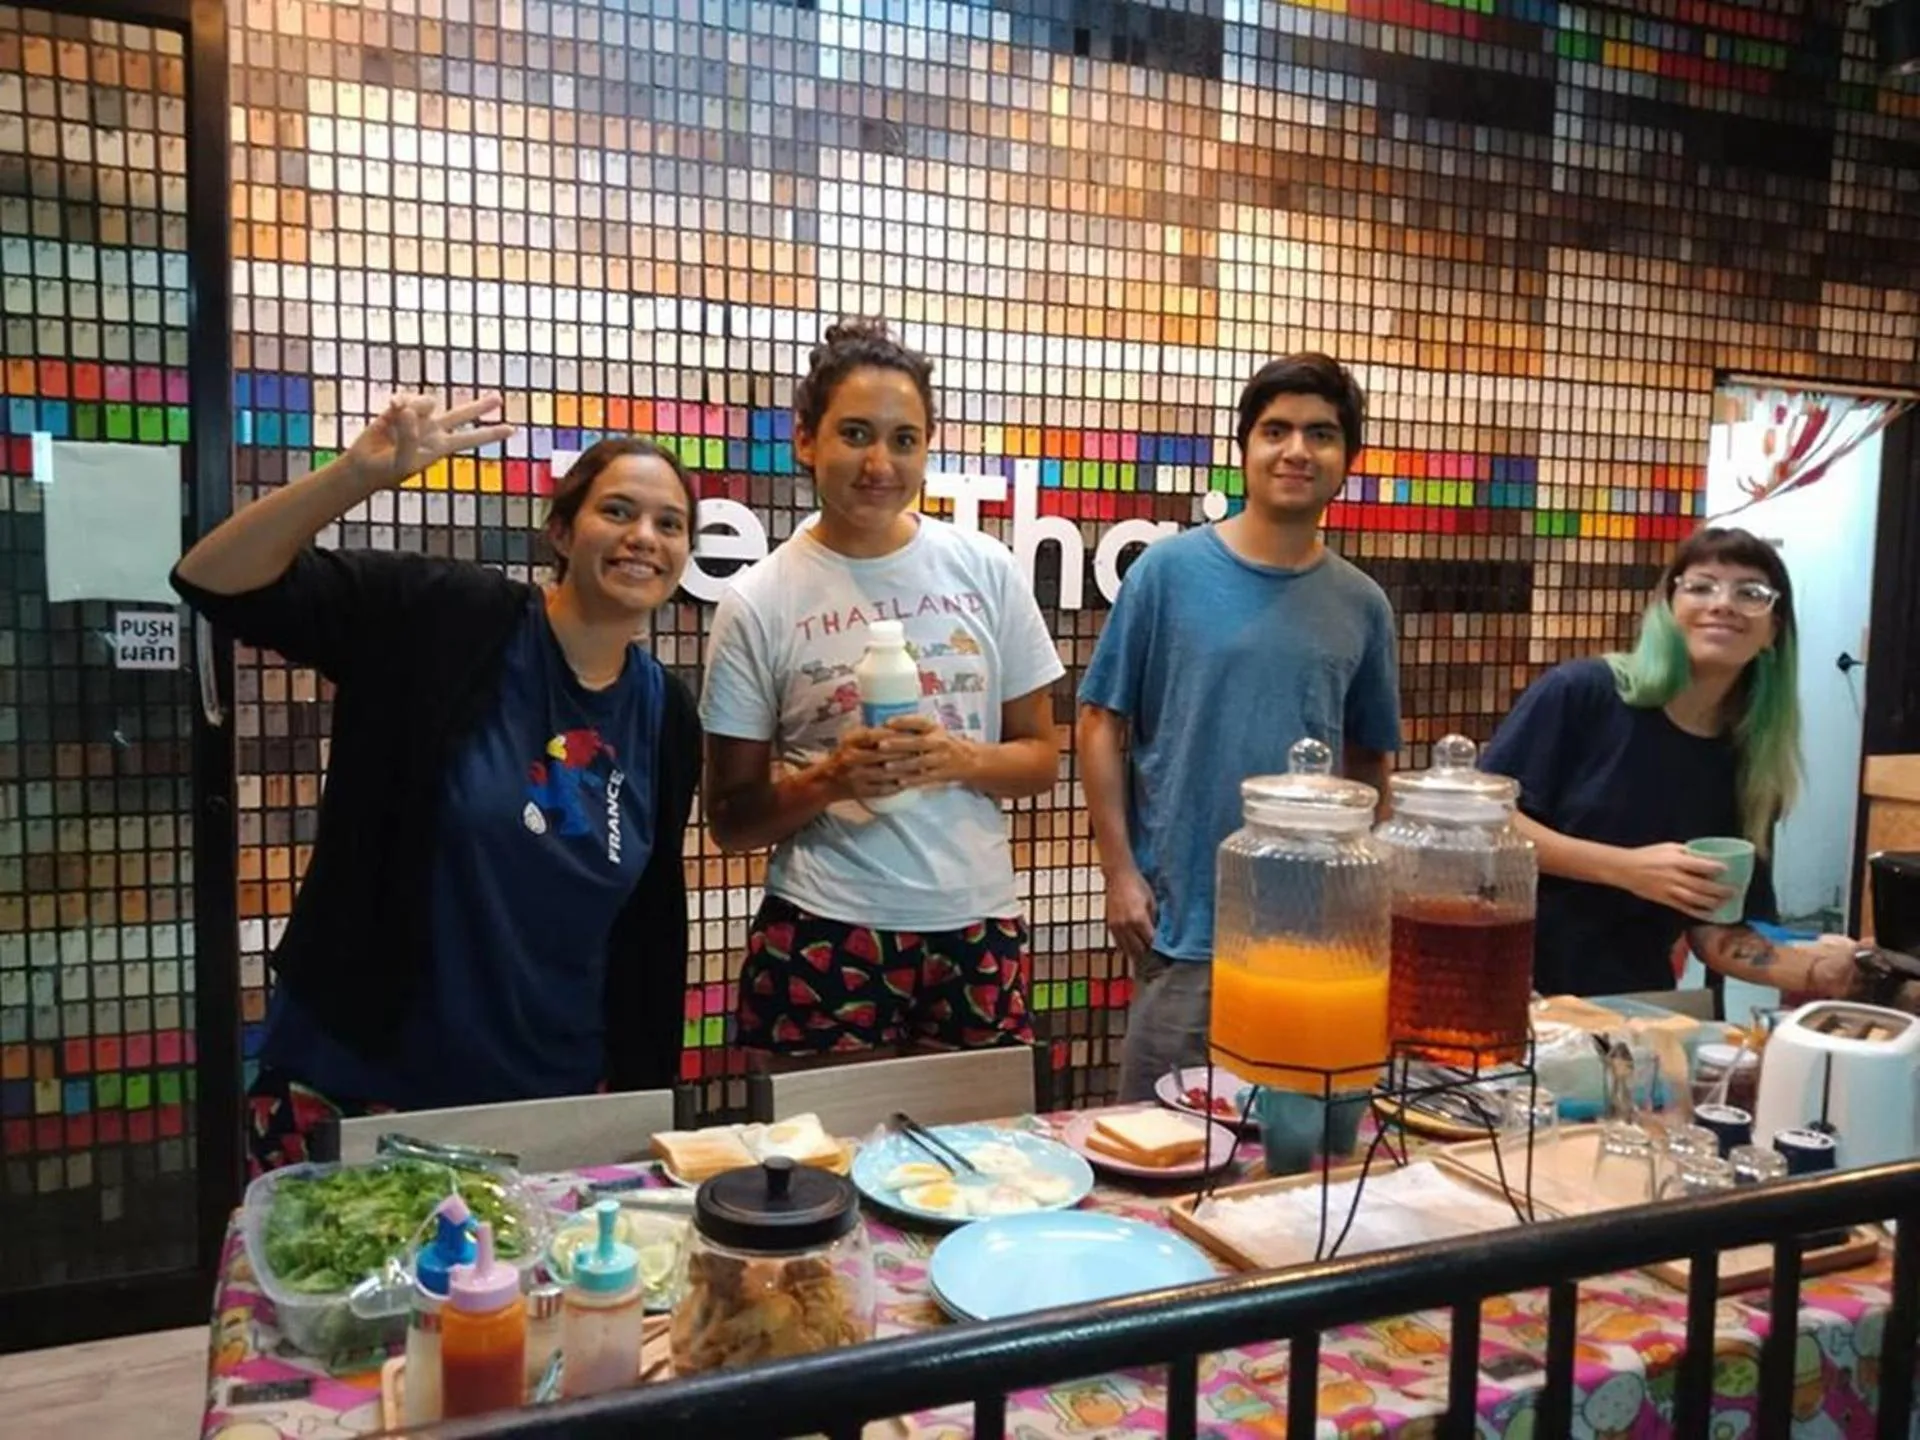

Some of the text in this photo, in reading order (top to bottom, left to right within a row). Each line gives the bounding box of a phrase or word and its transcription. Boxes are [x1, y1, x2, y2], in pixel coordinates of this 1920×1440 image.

[925, 458, 1228, 610] Tha
[120, 619, 175, 638] PUSH
[796, 591, 984, 641] THAILAND
[120, 638, 176, 663] ผลัก
[606, 768, 626, 865] FRANCE
